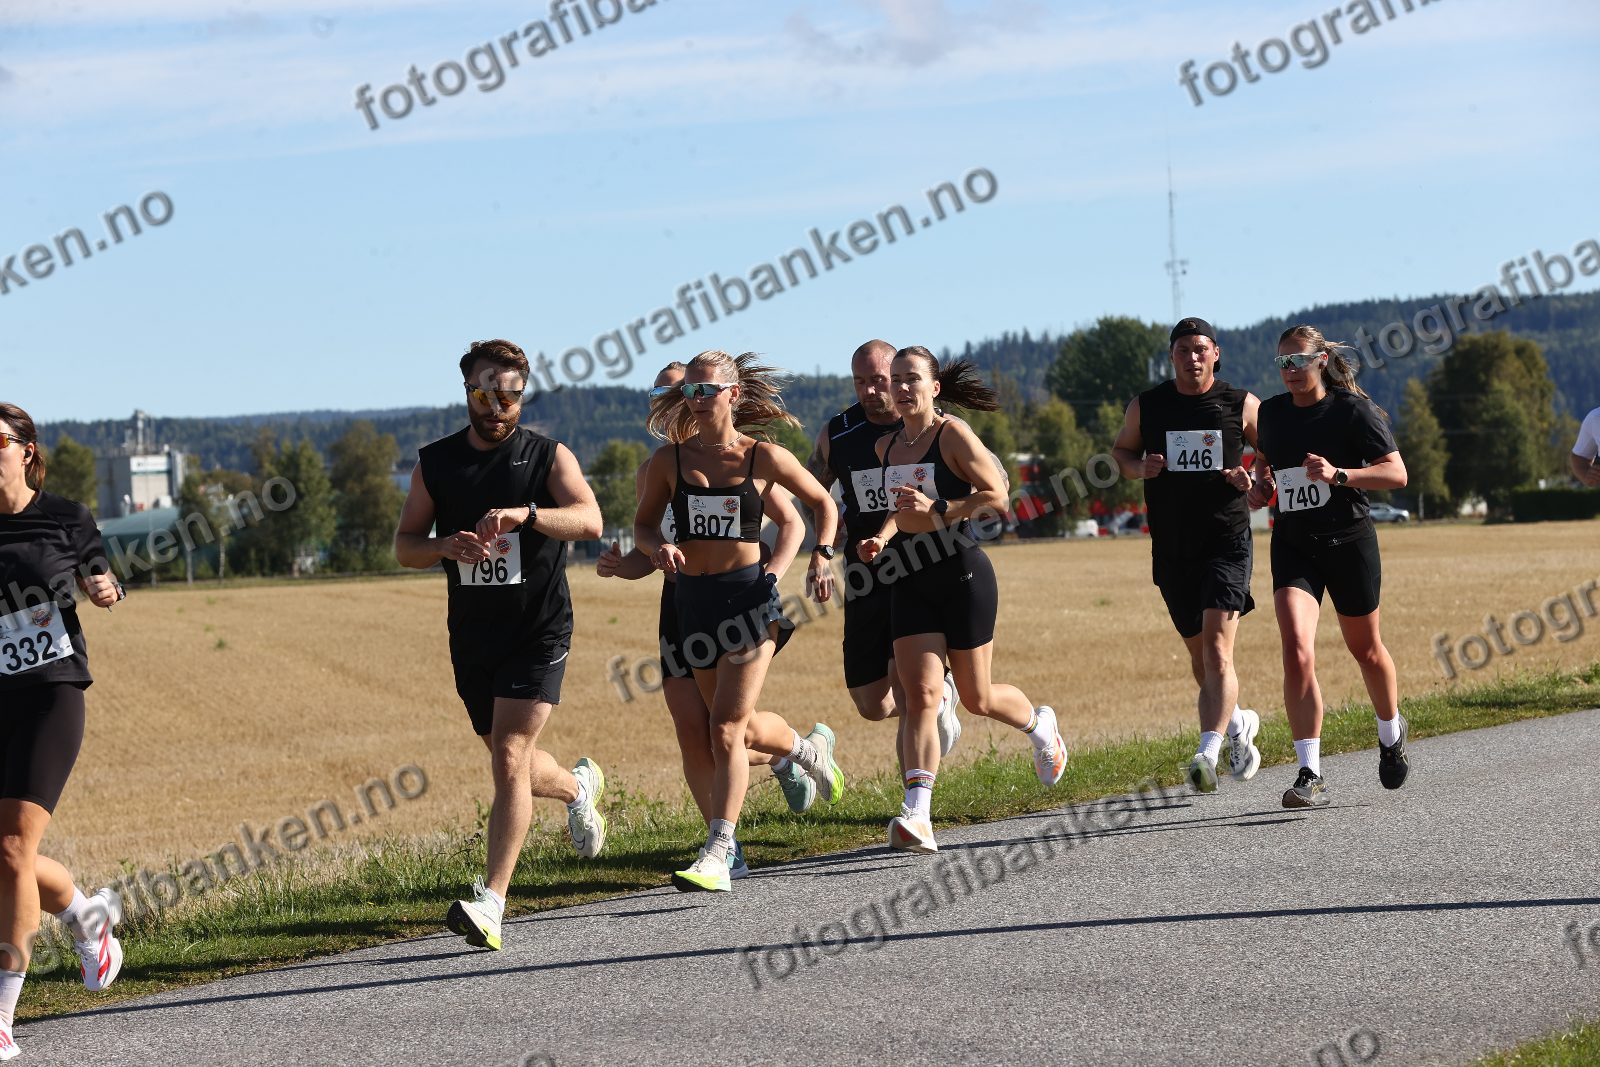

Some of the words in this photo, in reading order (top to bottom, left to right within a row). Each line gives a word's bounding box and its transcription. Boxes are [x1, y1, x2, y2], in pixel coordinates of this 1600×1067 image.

[1176, 448, 1213, 470] 446
[1284, 483, 1321, 510] 740
[693, 513, 735, 538] 807
[471, 557, 508, 584] 796
[2, 630, 58, 672] 332
